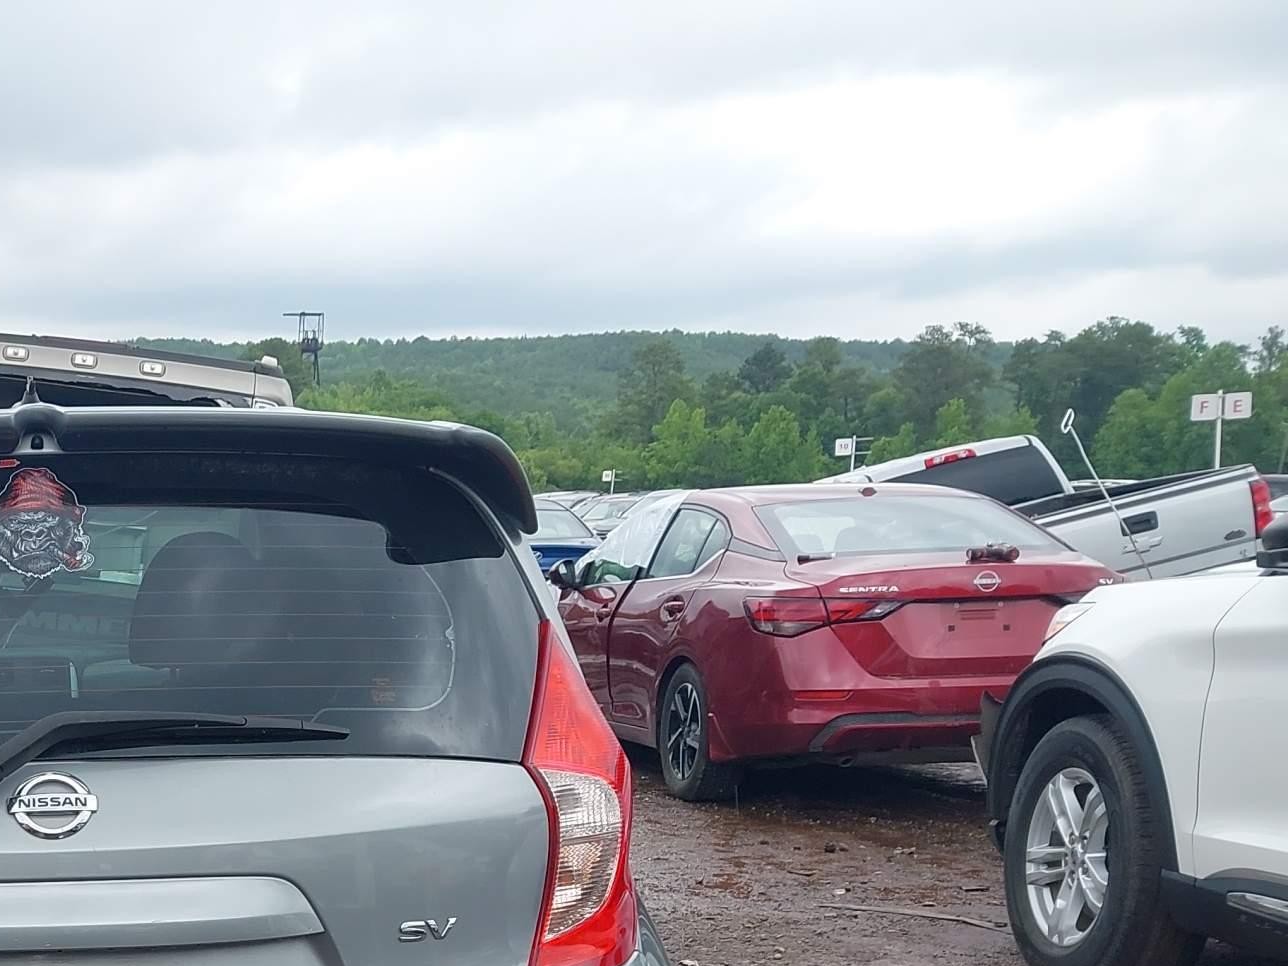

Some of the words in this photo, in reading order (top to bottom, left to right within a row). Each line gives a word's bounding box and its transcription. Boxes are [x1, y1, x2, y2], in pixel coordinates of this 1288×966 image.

[1199, 400, 1209, 414] F
[1232, 399, 1243, 413] E
[839, 585, 900, 593] SENTRA
[18, 796, 88, 809] NISSAN
[398, 917, 457, 942] SV
